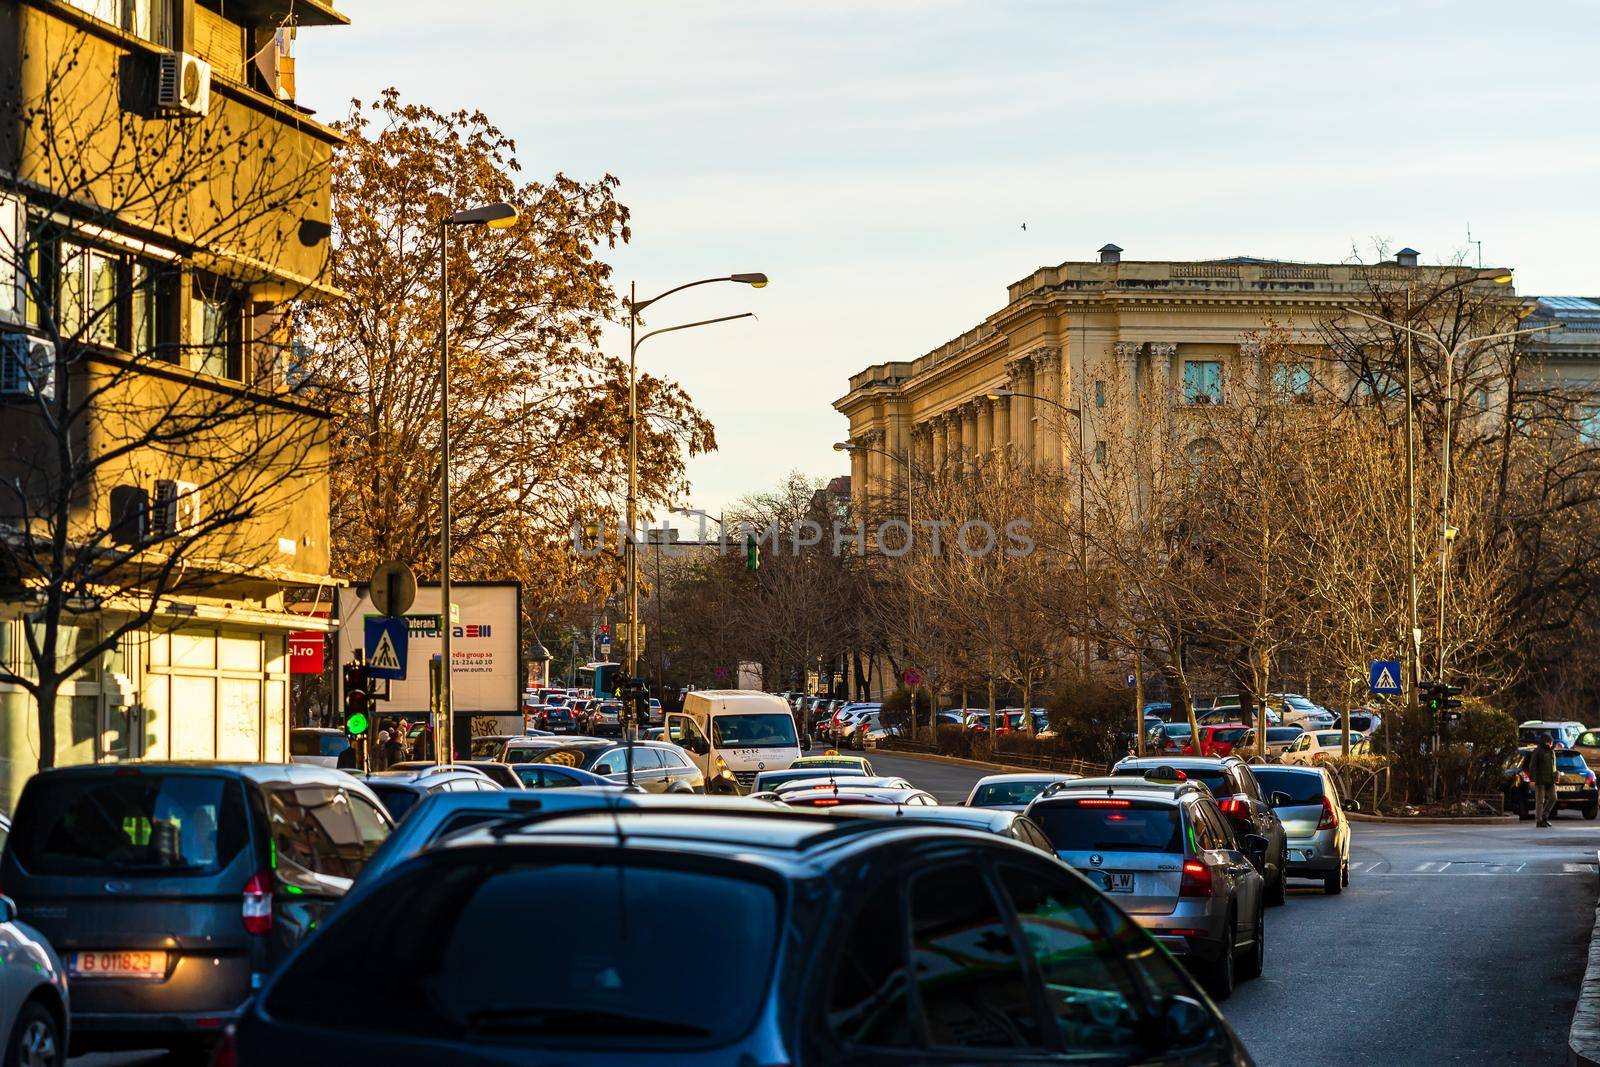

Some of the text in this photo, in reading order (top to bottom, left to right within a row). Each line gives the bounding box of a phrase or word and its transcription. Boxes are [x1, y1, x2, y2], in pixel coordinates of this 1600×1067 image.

[466, 652, 485, 660] group
[1128, 674, 1135, 683] P
[84, 952, 151, 971] B 011829
